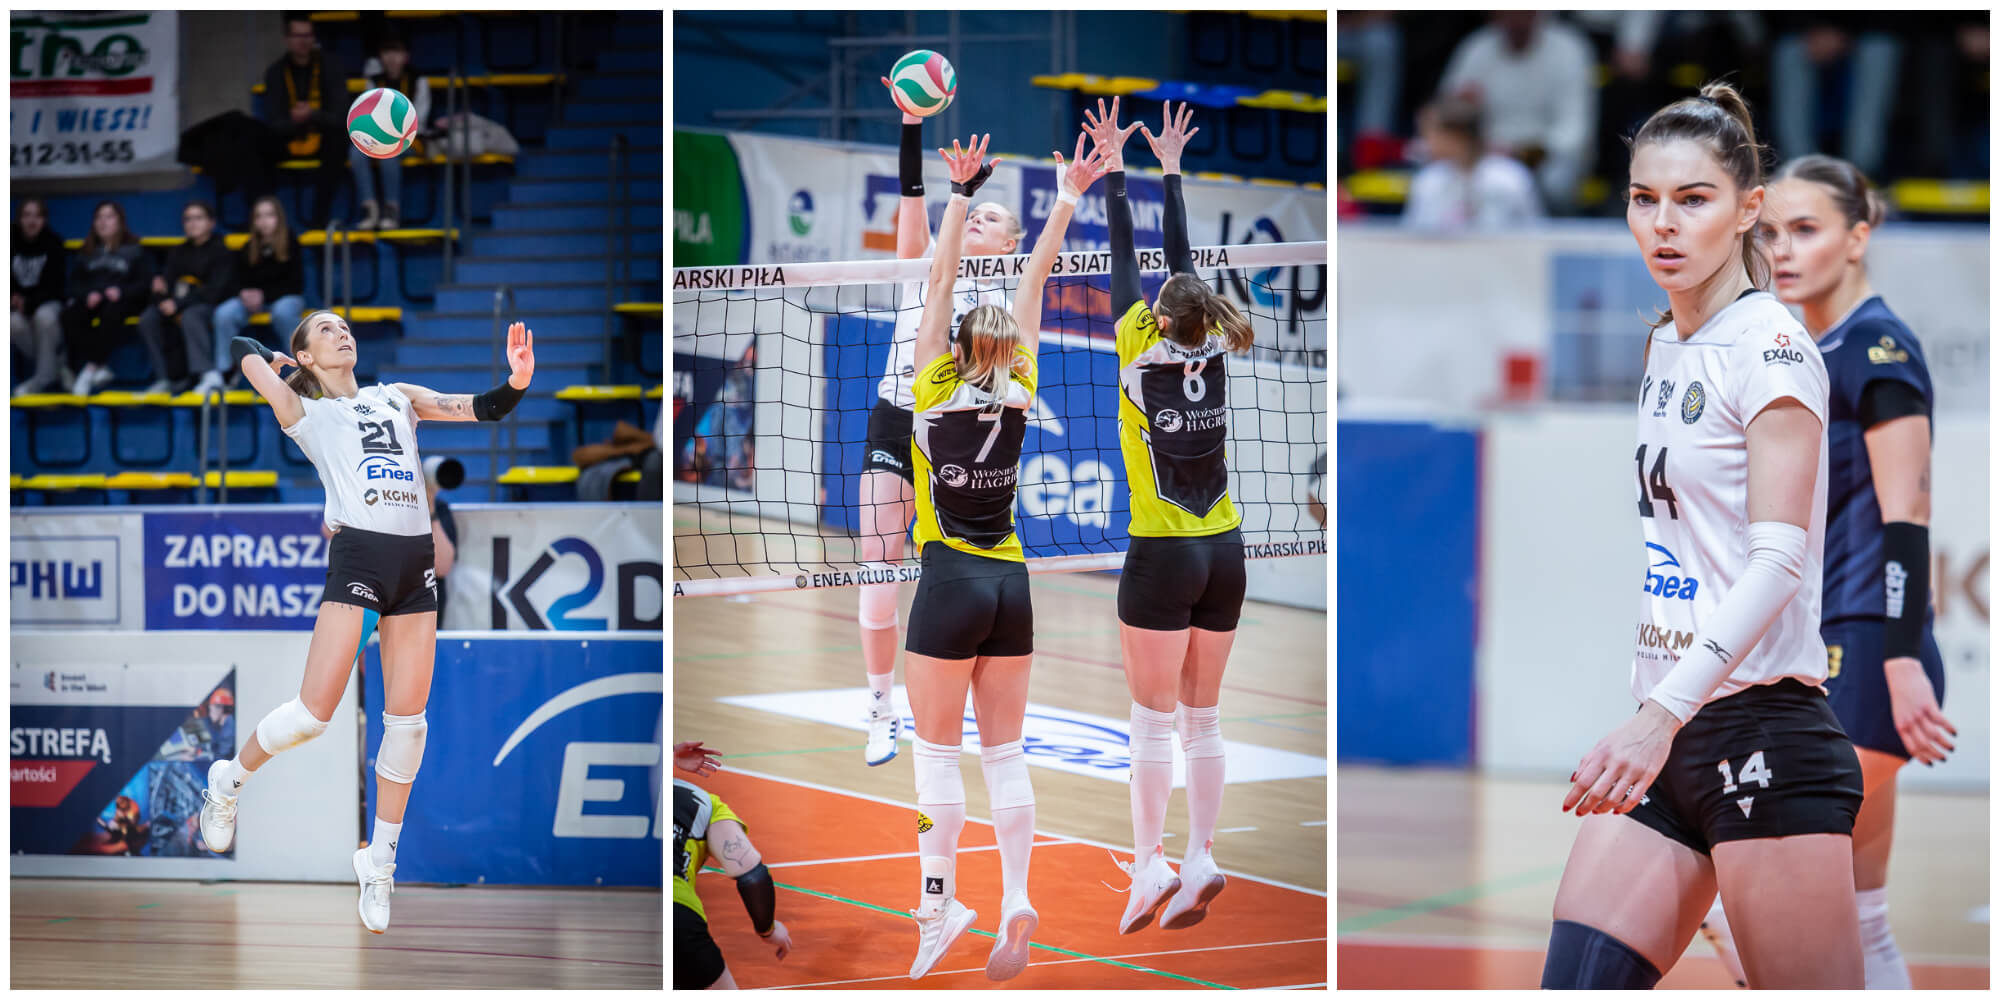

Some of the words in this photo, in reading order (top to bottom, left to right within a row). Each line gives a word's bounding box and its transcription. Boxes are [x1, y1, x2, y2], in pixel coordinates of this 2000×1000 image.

[57, 105, 153, 132] WIESZ!
[674, 268, 733, 290] ARSKI
[741, 267, 786, 287] PIŁA
[1013, 255, 1063, 275] KB
[1069, 250, 1167, 273] SIATRS
[1763, 348, 1804, 364] EXALO
[1183, 359, 1207, 402] 8
[358, 419, 404, 455] 21
[974, 411, 1004, 463] 7
[367, 464, 414, 481] Enea
[1635, 443, 1679, 521] 14
[382, 489, 418, 504] KGHM
[163, 535, 330, 568] ZAPRASZ
[1243, 541, 1303, 559] TKARSKI
[813, 572, 853, 588] ENEA
[856, 568, 896, 585] KLUB
[173, 584, 226, 617] DO
[233, 584, 327, 617] NASZ
[10, 728, 112, 764] STREFĄ
[1718, 750, 1772, 795] 14
[553, 741, 663, 839] E
